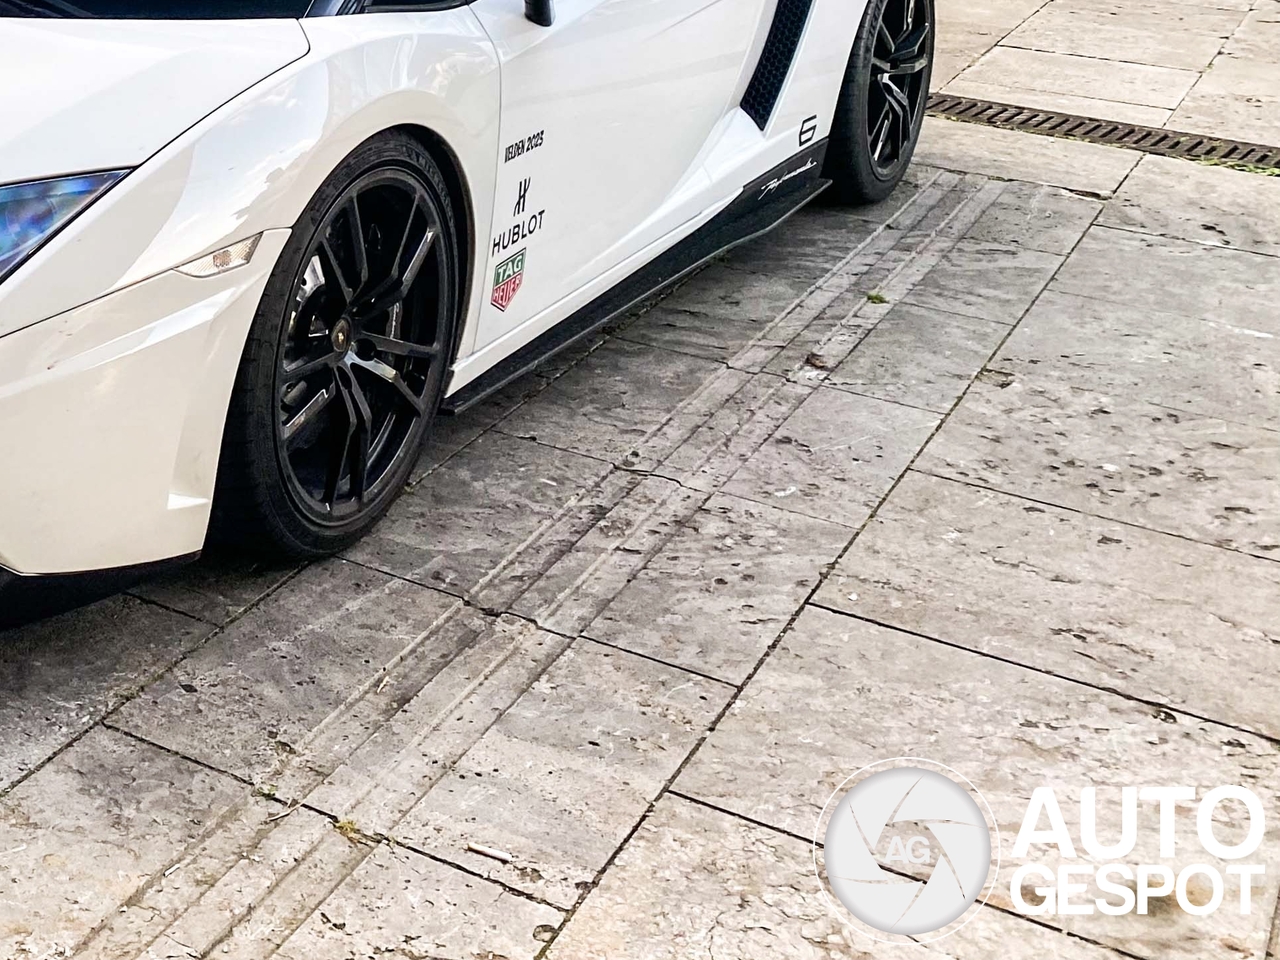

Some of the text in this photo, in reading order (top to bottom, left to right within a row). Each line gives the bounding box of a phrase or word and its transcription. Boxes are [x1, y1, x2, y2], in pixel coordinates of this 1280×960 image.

[799, 114, 817, 148] 6
[491, 209, 546, 258] HUBLOT
[497, 254, 523, 283] TAG
[492, 275, 521, 306] HEUER
